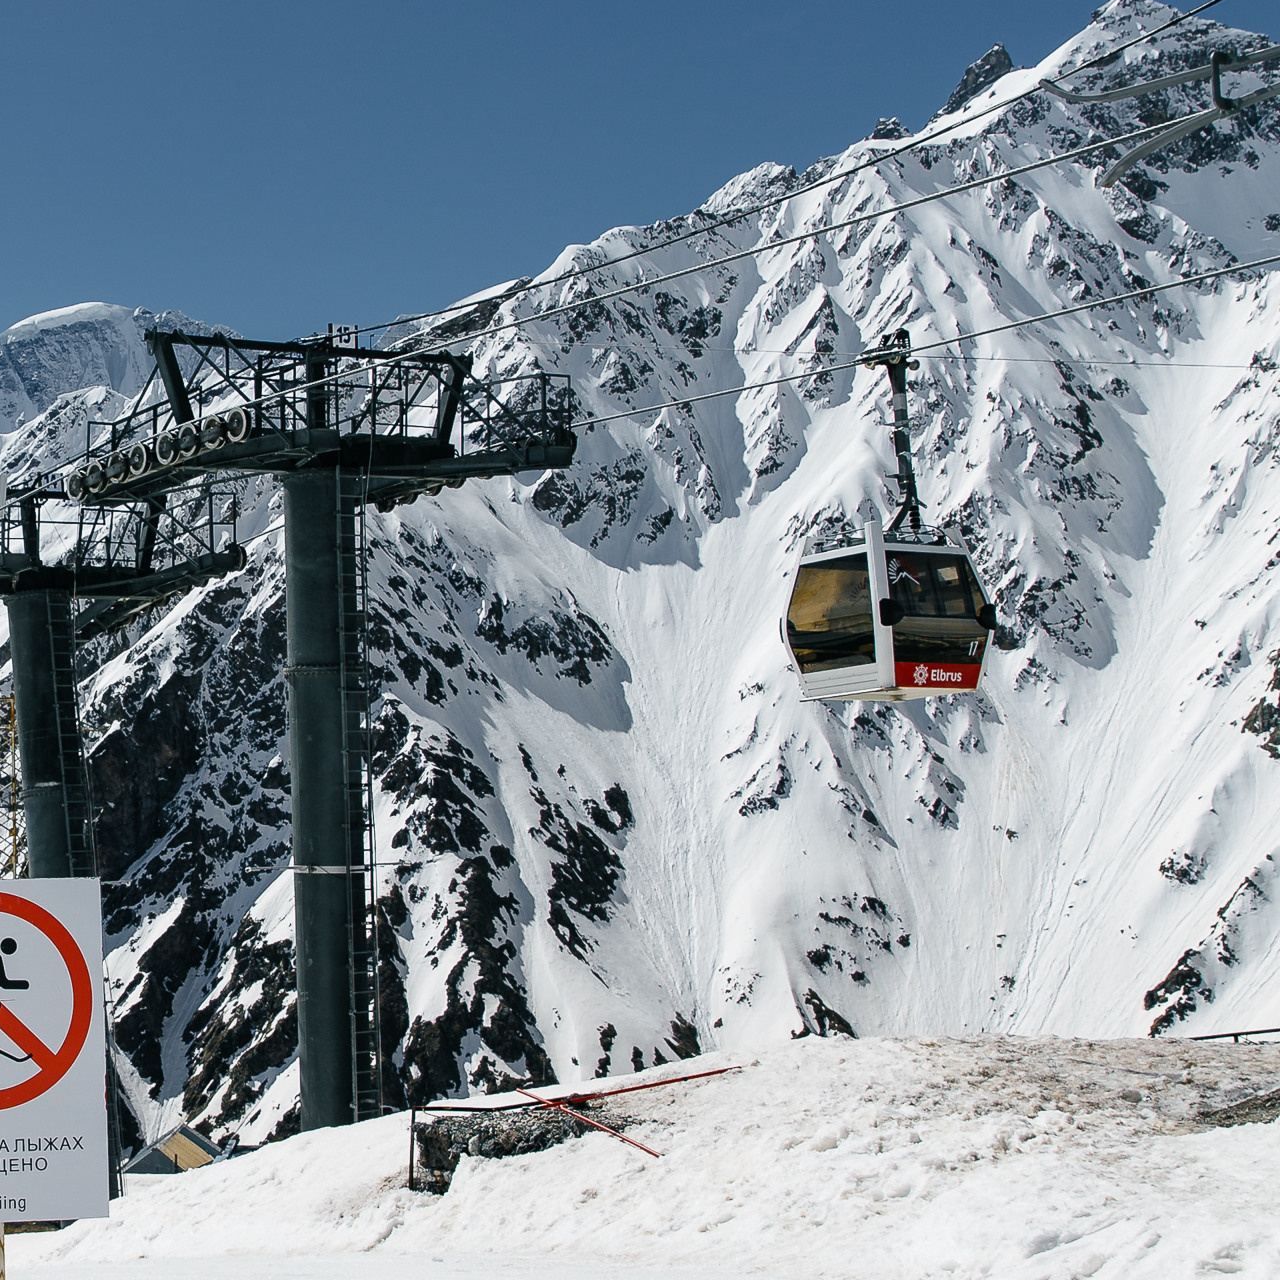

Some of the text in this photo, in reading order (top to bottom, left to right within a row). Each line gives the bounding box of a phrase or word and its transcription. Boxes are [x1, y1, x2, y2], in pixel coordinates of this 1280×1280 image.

[336, 325, 351, 344] 15
[968, 641, 979, 656] 17
[930, 669, 963, 682] Elbrus
[13, 1136, 84, 1152] ЛЫЖАХ
